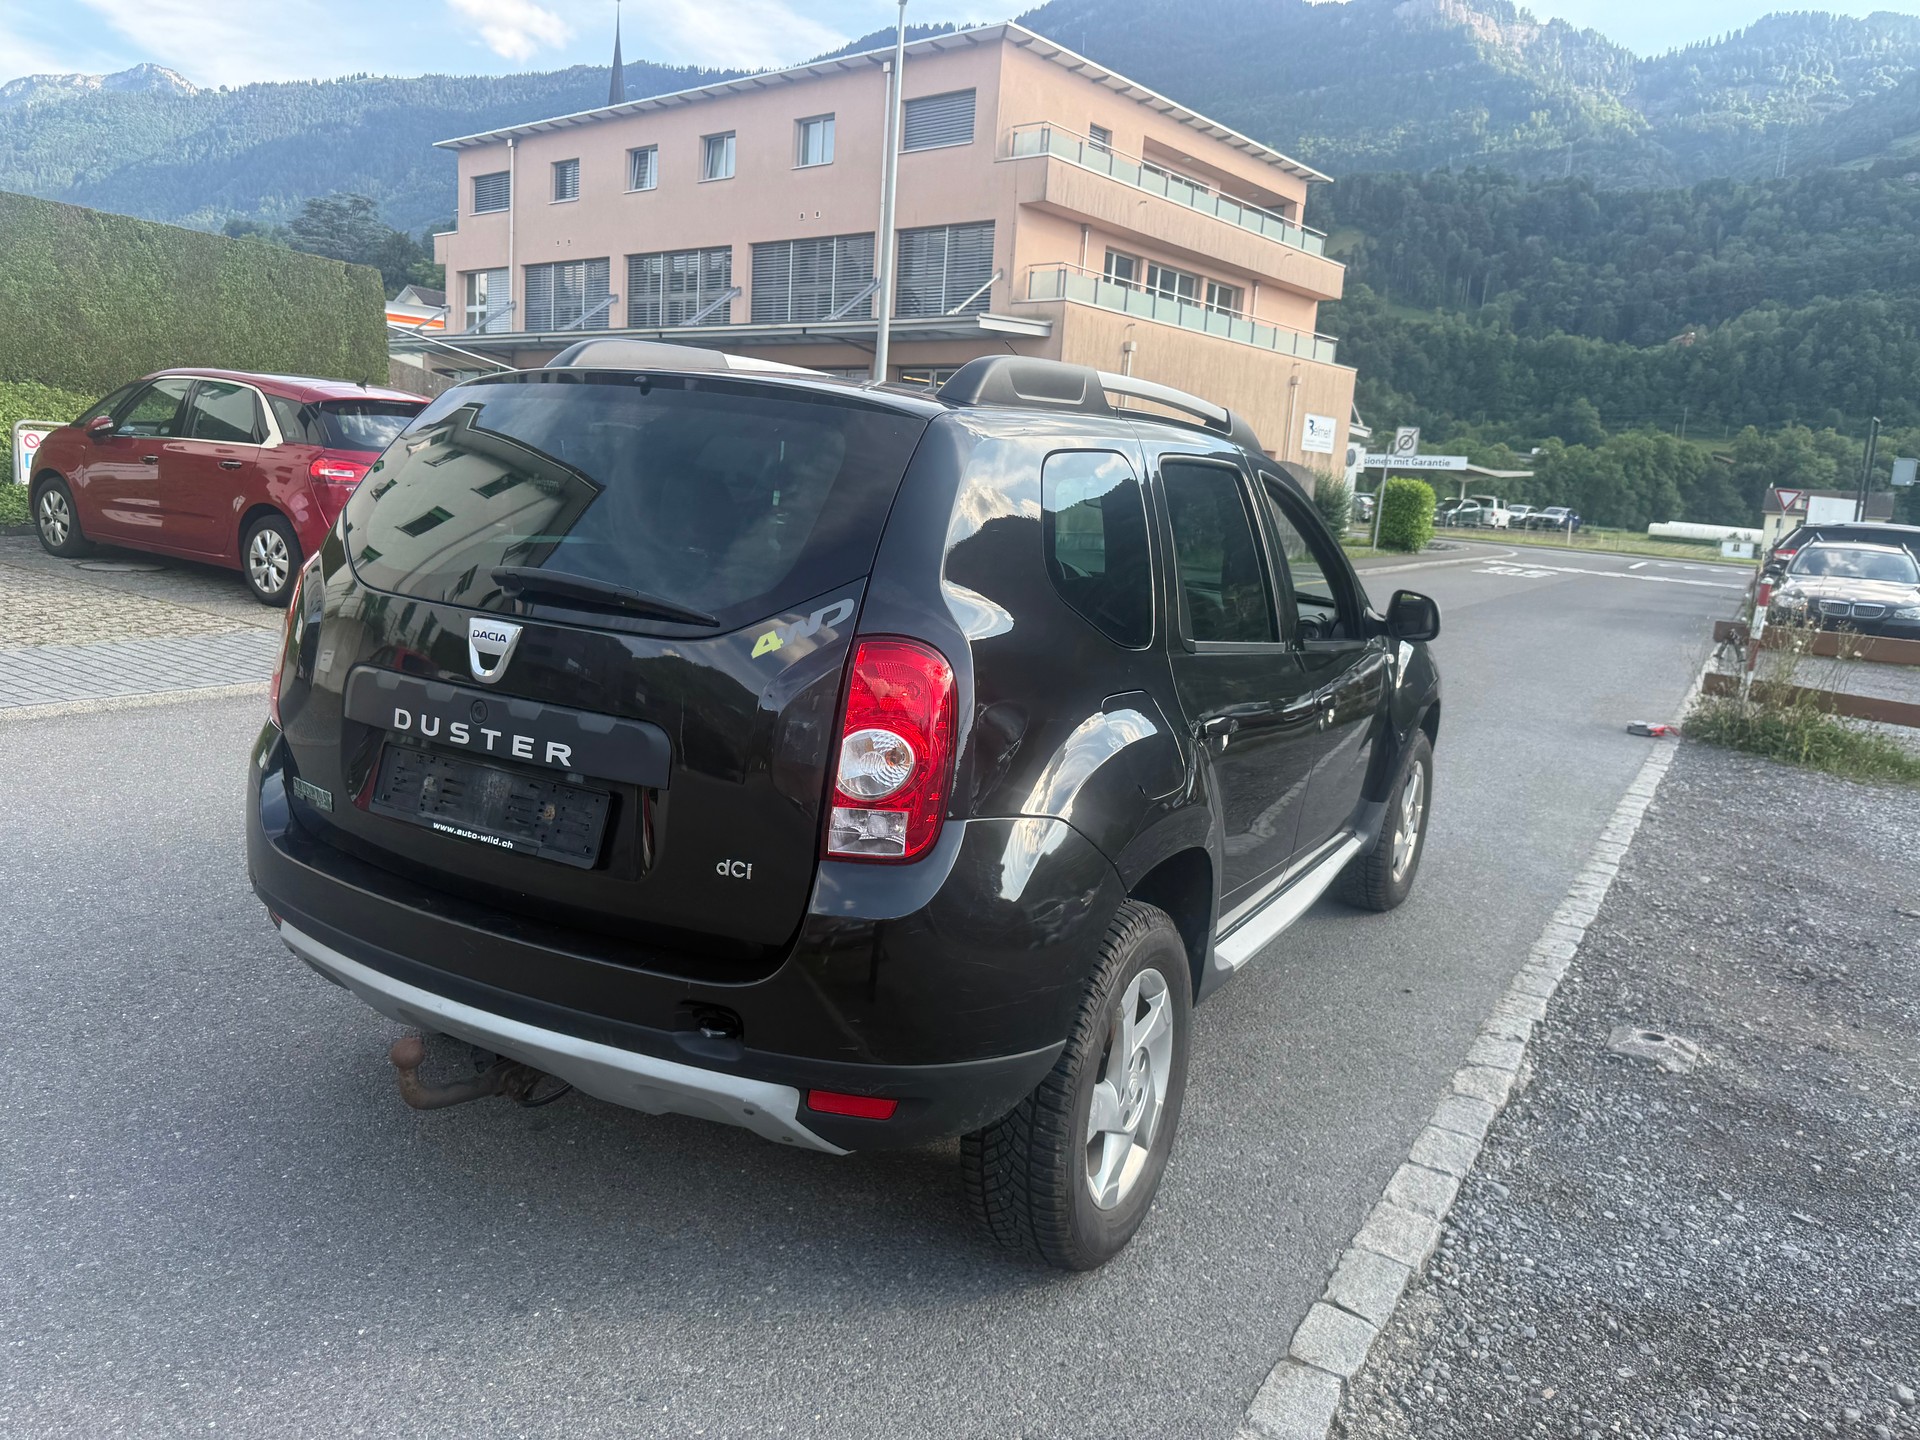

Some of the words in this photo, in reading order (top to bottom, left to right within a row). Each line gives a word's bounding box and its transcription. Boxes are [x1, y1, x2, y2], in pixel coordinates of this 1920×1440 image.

[1394, 457, 1409, 466] mit
[1412, 458, 1451, 467] Garantie
[472, 629, 507, 643] DACIA
[393, 707, 572, 767] DUSTER
[433, 822, 514, 849] www.auto-wild.ch
